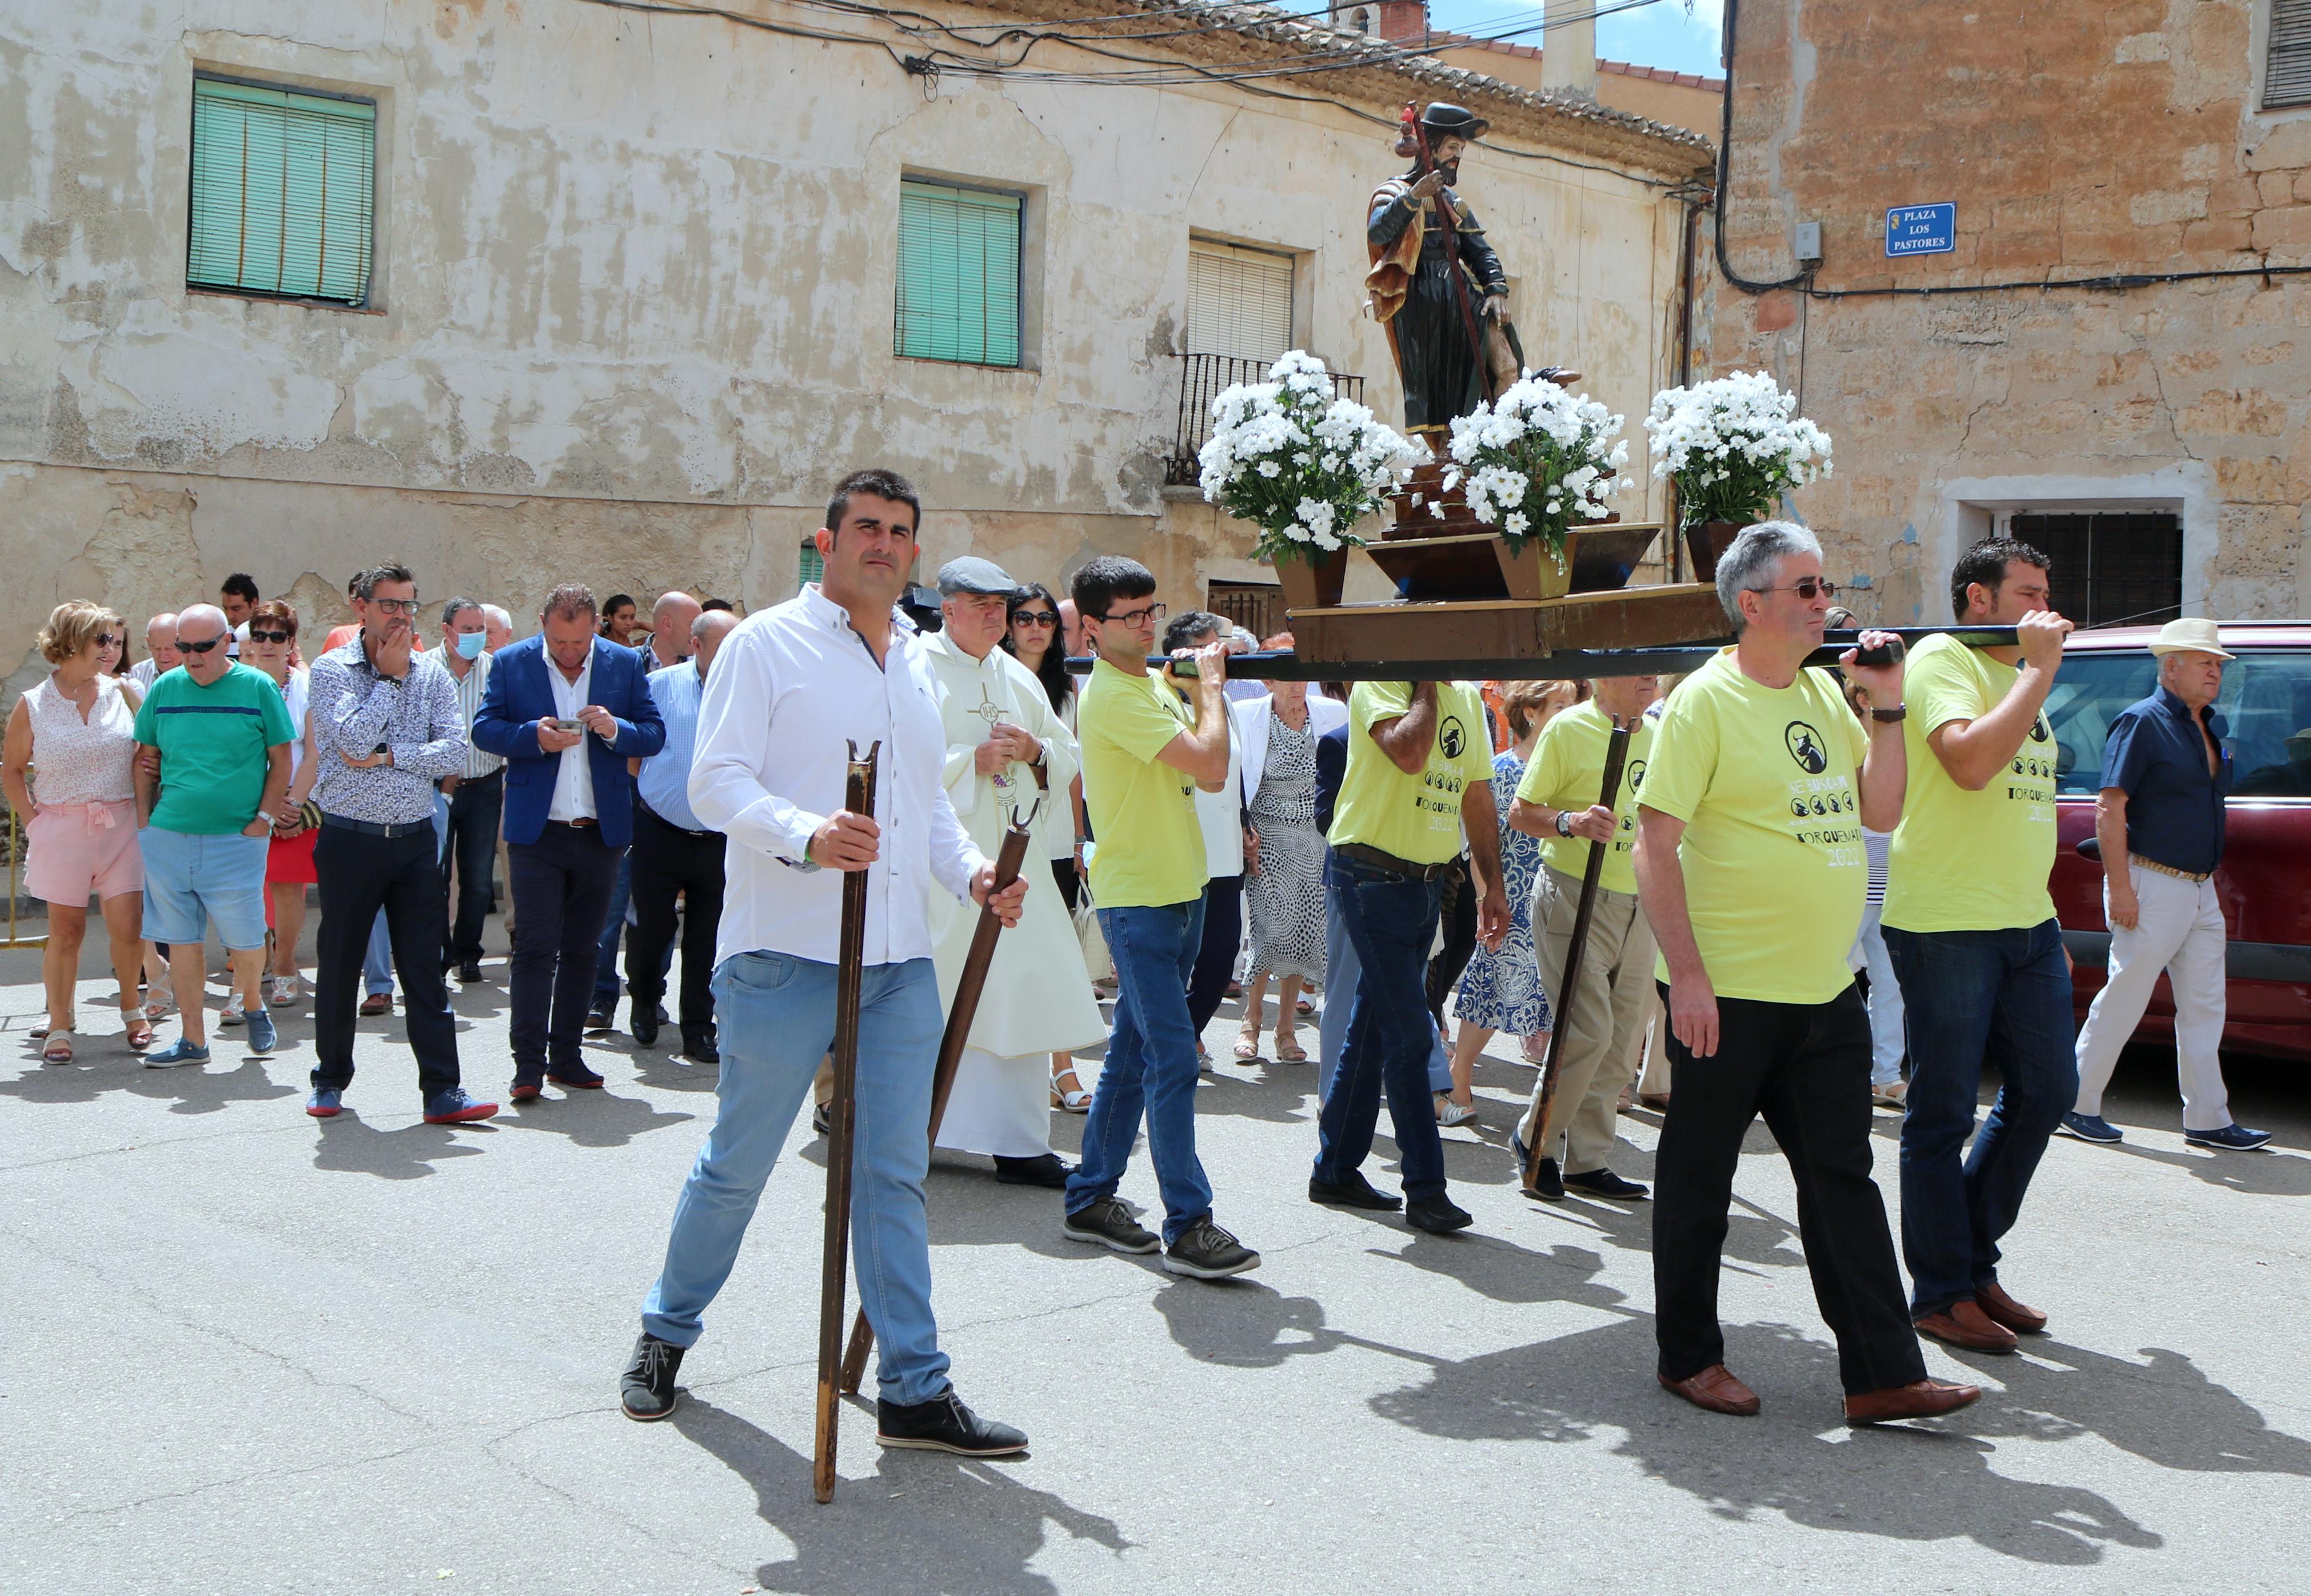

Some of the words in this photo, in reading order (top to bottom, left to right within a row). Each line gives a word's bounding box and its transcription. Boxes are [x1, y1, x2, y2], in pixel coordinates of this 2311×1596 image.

[1904, 210, 1937, 221] PLAZA
[1909, 224, 1930, 235] LOS
[1894, 237, 1945, 250] PASTORES
[1789, 780, 1805, 795] SE
[1806, 775, 1847, 792] BUSCAN
[1827, 848, 1860, 867] 2022
